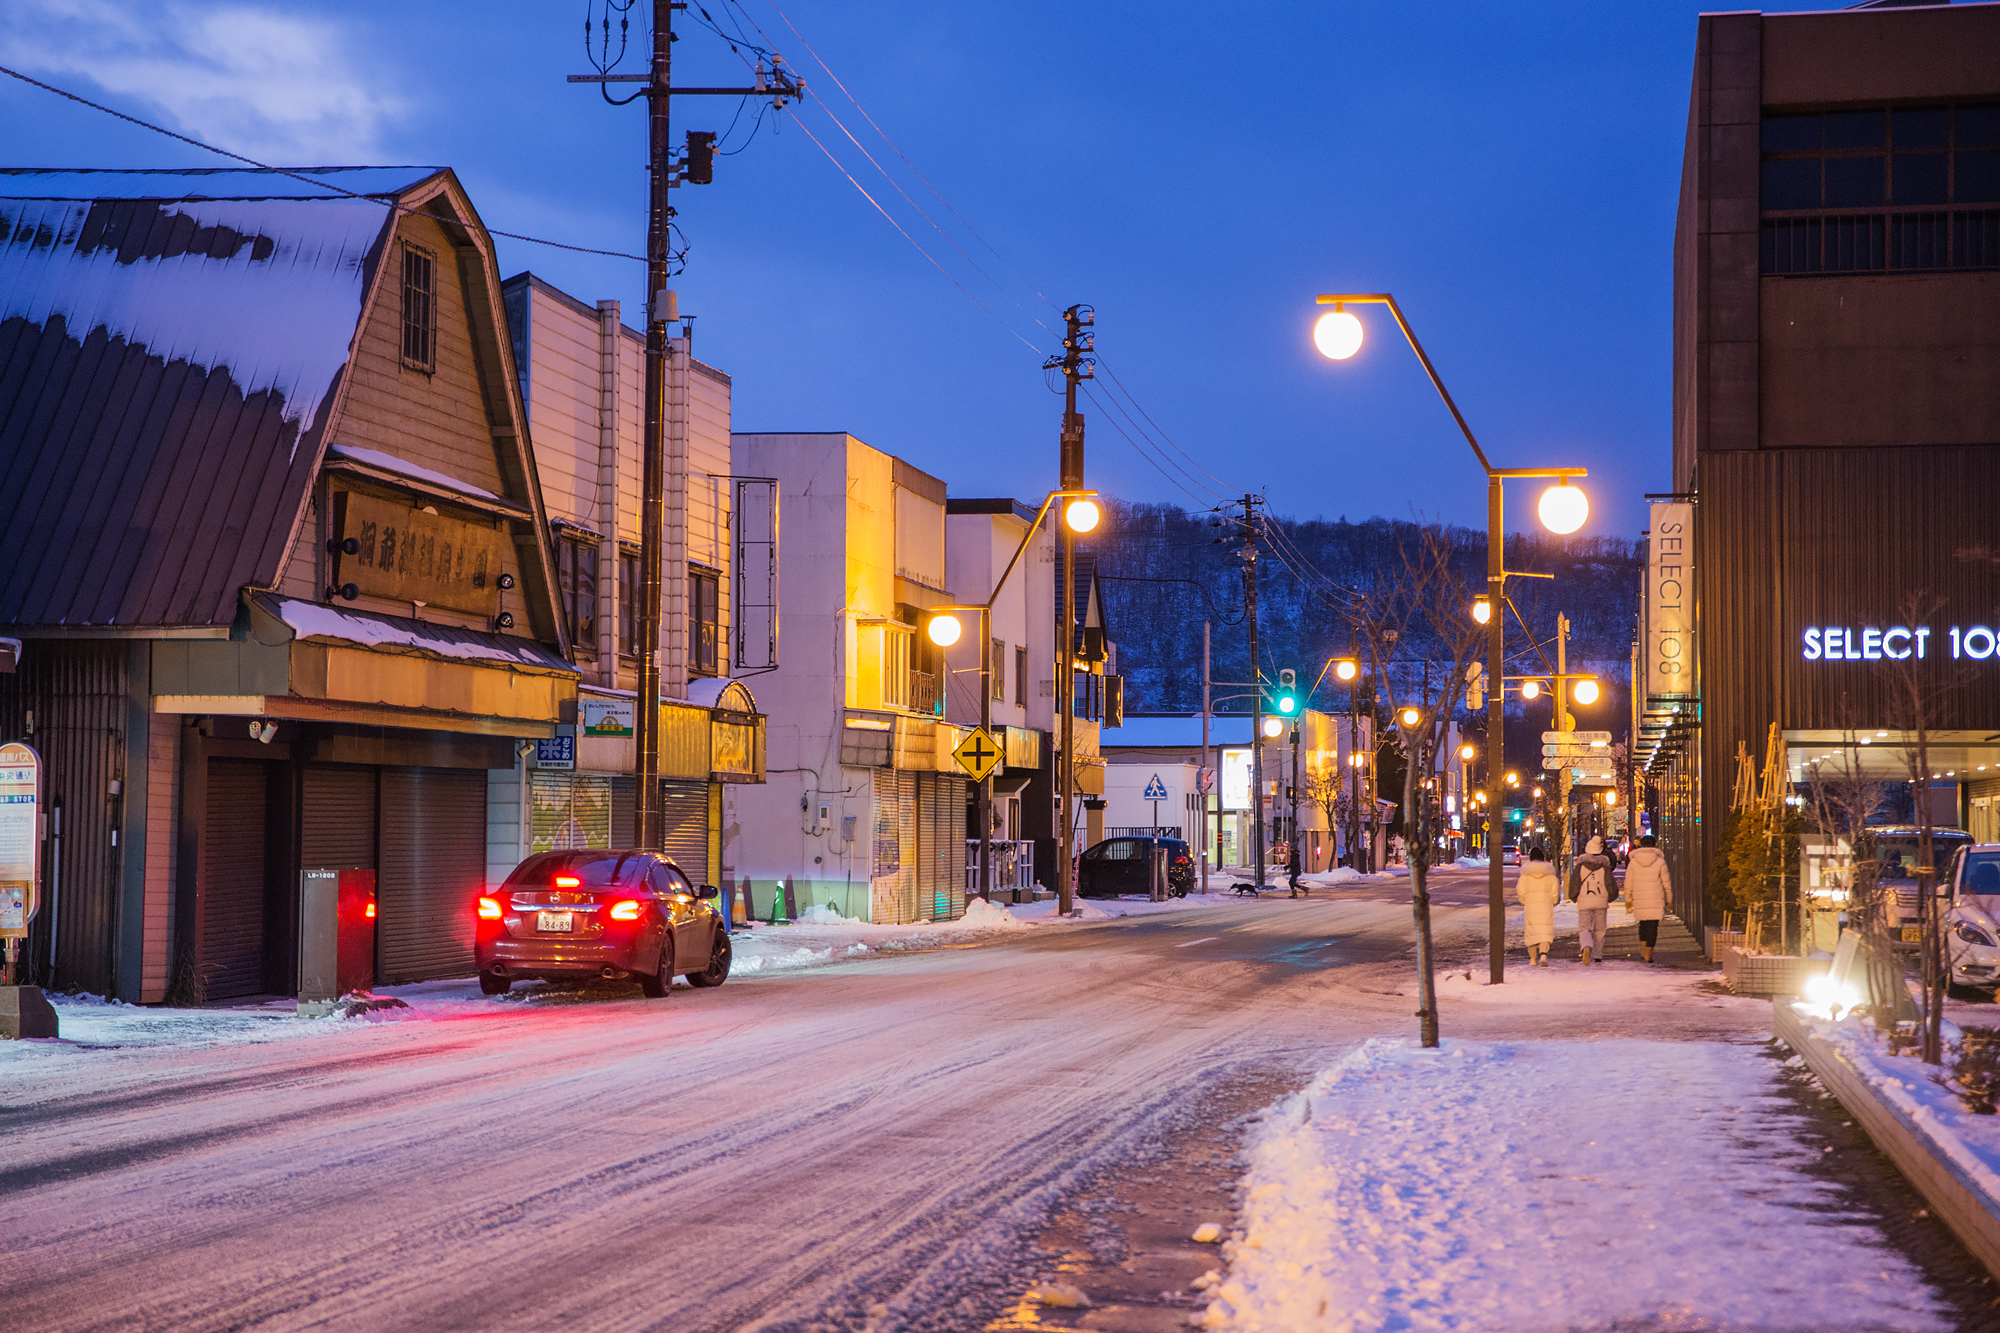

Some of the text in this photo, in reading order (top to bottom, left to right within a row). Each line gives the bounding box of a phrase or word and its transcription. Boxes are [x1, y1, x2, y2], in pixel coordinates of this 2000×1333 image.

[1659, 522, 1682, 675] SELECT 108
[1803, 626, 2000, 660] SELECT 10
[540, 737, 561, 759] 米
[562, 737, 570, 760] おこめ
[14, 795, 32, 803] STOP
